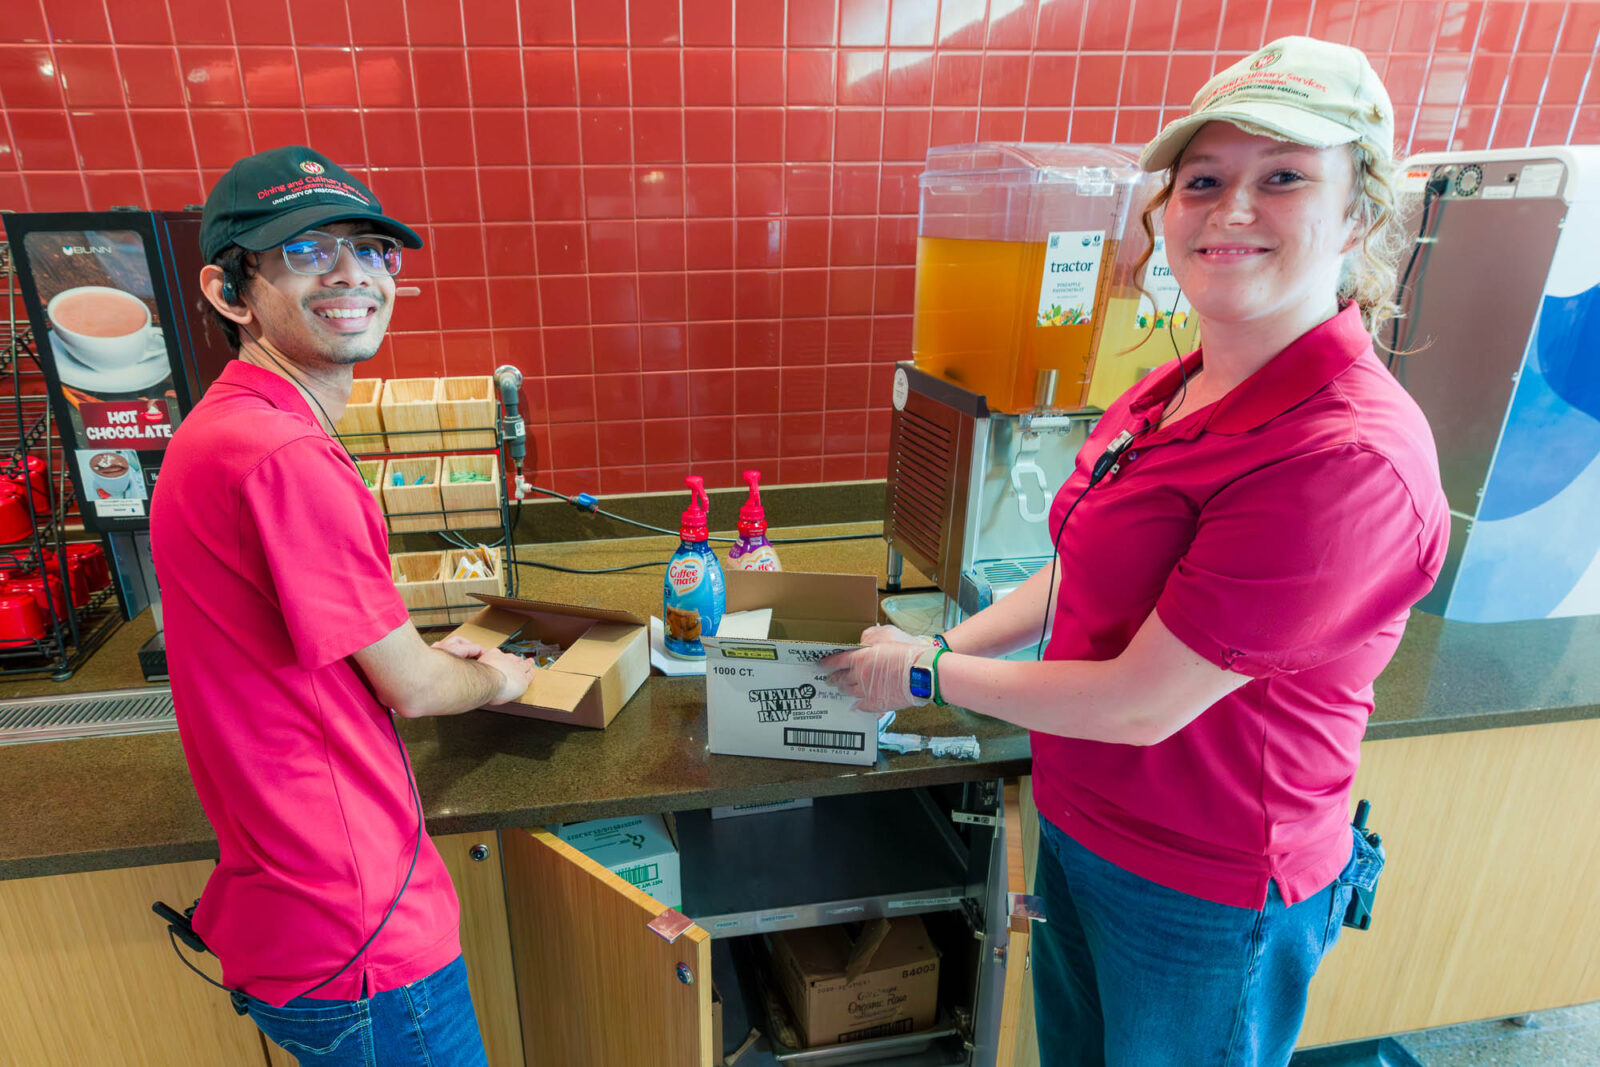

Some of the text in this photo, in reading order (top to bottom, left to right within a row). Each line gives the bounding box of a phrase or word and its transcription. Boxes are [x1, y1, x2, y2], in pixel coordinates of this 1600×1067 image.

[305, 162, 321, 173] W
[257, 184, 287, 200] Dining
[287, 178, 304, 190] and
[304, 175, 341, 188] Culinary
[272, 190, 305, 206] UNIVERSITY
[73, 246, 112, 255] BUNN
[1051, 261, 1093, 273] tractor
[106, 410, 138, 425] HOT
[86, 424, 174, 440] CHOCOLATE
[669, 565, 698, 579] Coffee
[673, 575, 698, 586] mate
[713, 666, 755, 678] 1000 CT.
[749, 687, 800, 702] STEVIA
[760, 698, 812, 712] IN THE
[757, 709, 791, 722] RAW
